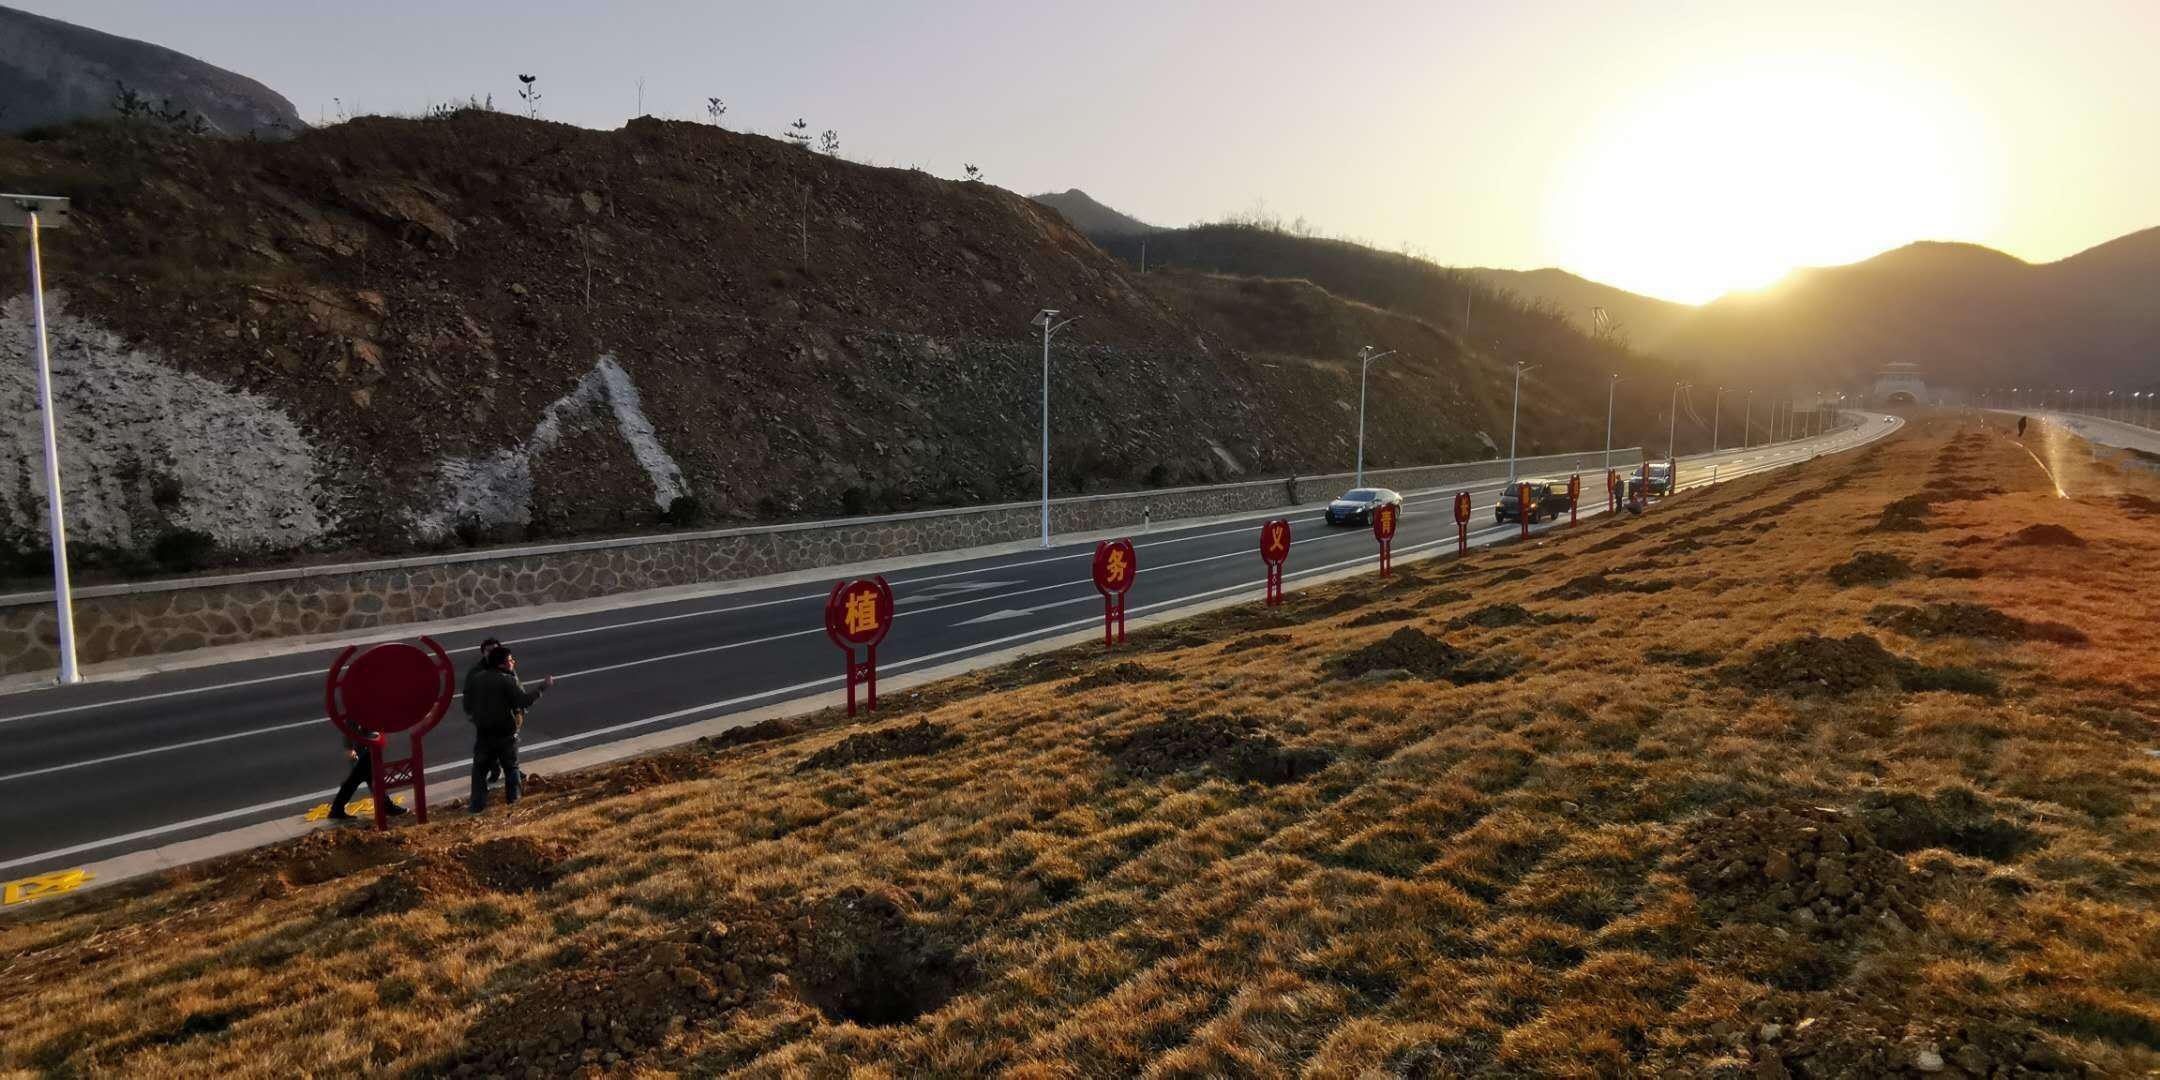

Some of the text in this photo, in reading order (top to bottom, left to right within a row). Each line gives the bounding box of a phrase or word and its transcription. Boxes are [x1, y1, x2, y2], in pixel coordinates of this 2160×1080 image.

[1270, 526, 1284, 551] 义
[1107, 549, 1127, 582] 务
[845, 590, 879, 635] 植
